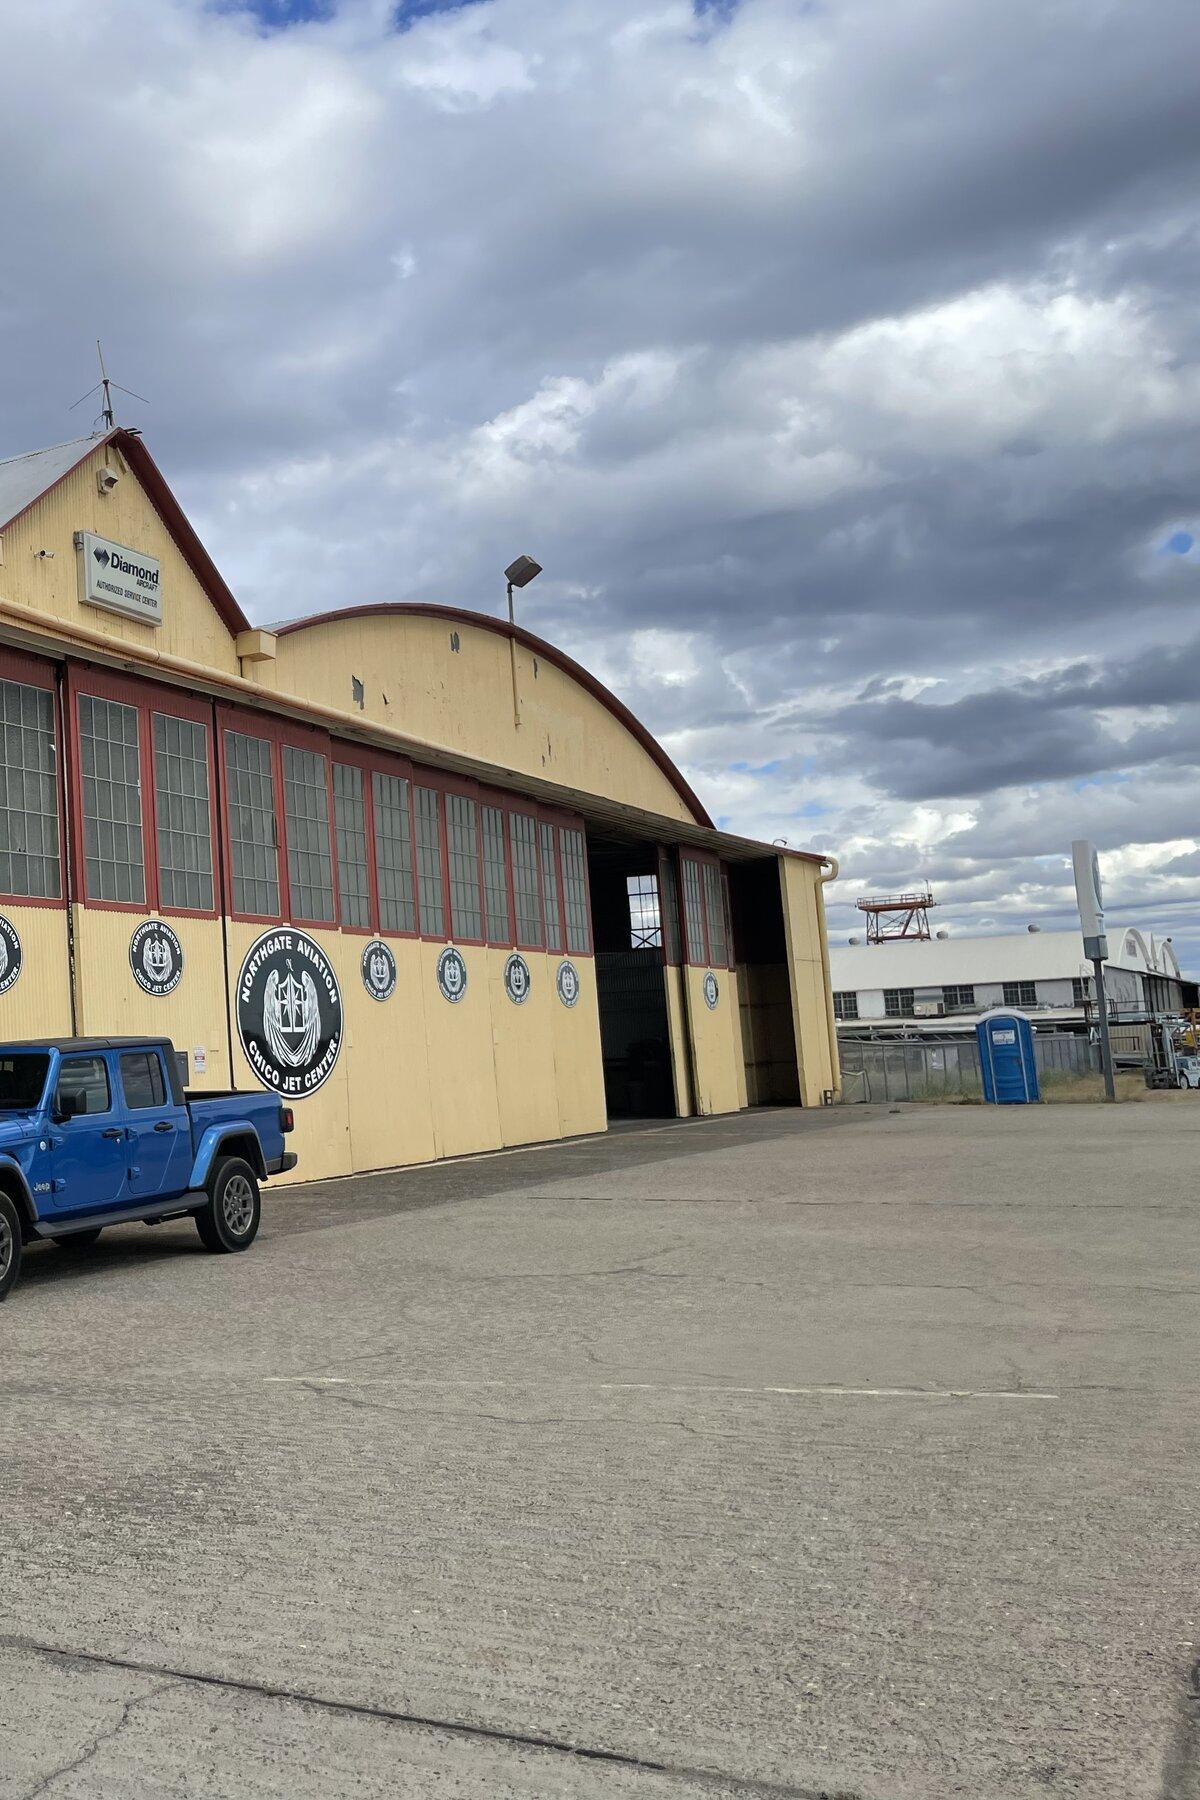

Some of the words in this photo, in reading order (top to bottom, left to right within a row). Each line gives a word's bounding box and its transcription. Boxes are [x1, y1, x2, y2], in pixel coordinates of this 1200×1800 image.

[110, 552, 159, 584] Diamond
[96, 580, 123, 596] AUTHORIZED
[124, 590, 141, 602] SERVICE
[142, 596, 158, 608] CENTER
[136, 579, 158, 592] AIRCRAFT
[241, 936, 292, 1003] NORTHGATE
[297, 940, 337, 1004] AVIATION
[249, 1040, 280, 1085] CHICO
[283, 1076, 301, 1091] JET
[304, 1039, 337, 1088] CENTER
[34, 1182, 50, 1191] Jeep
